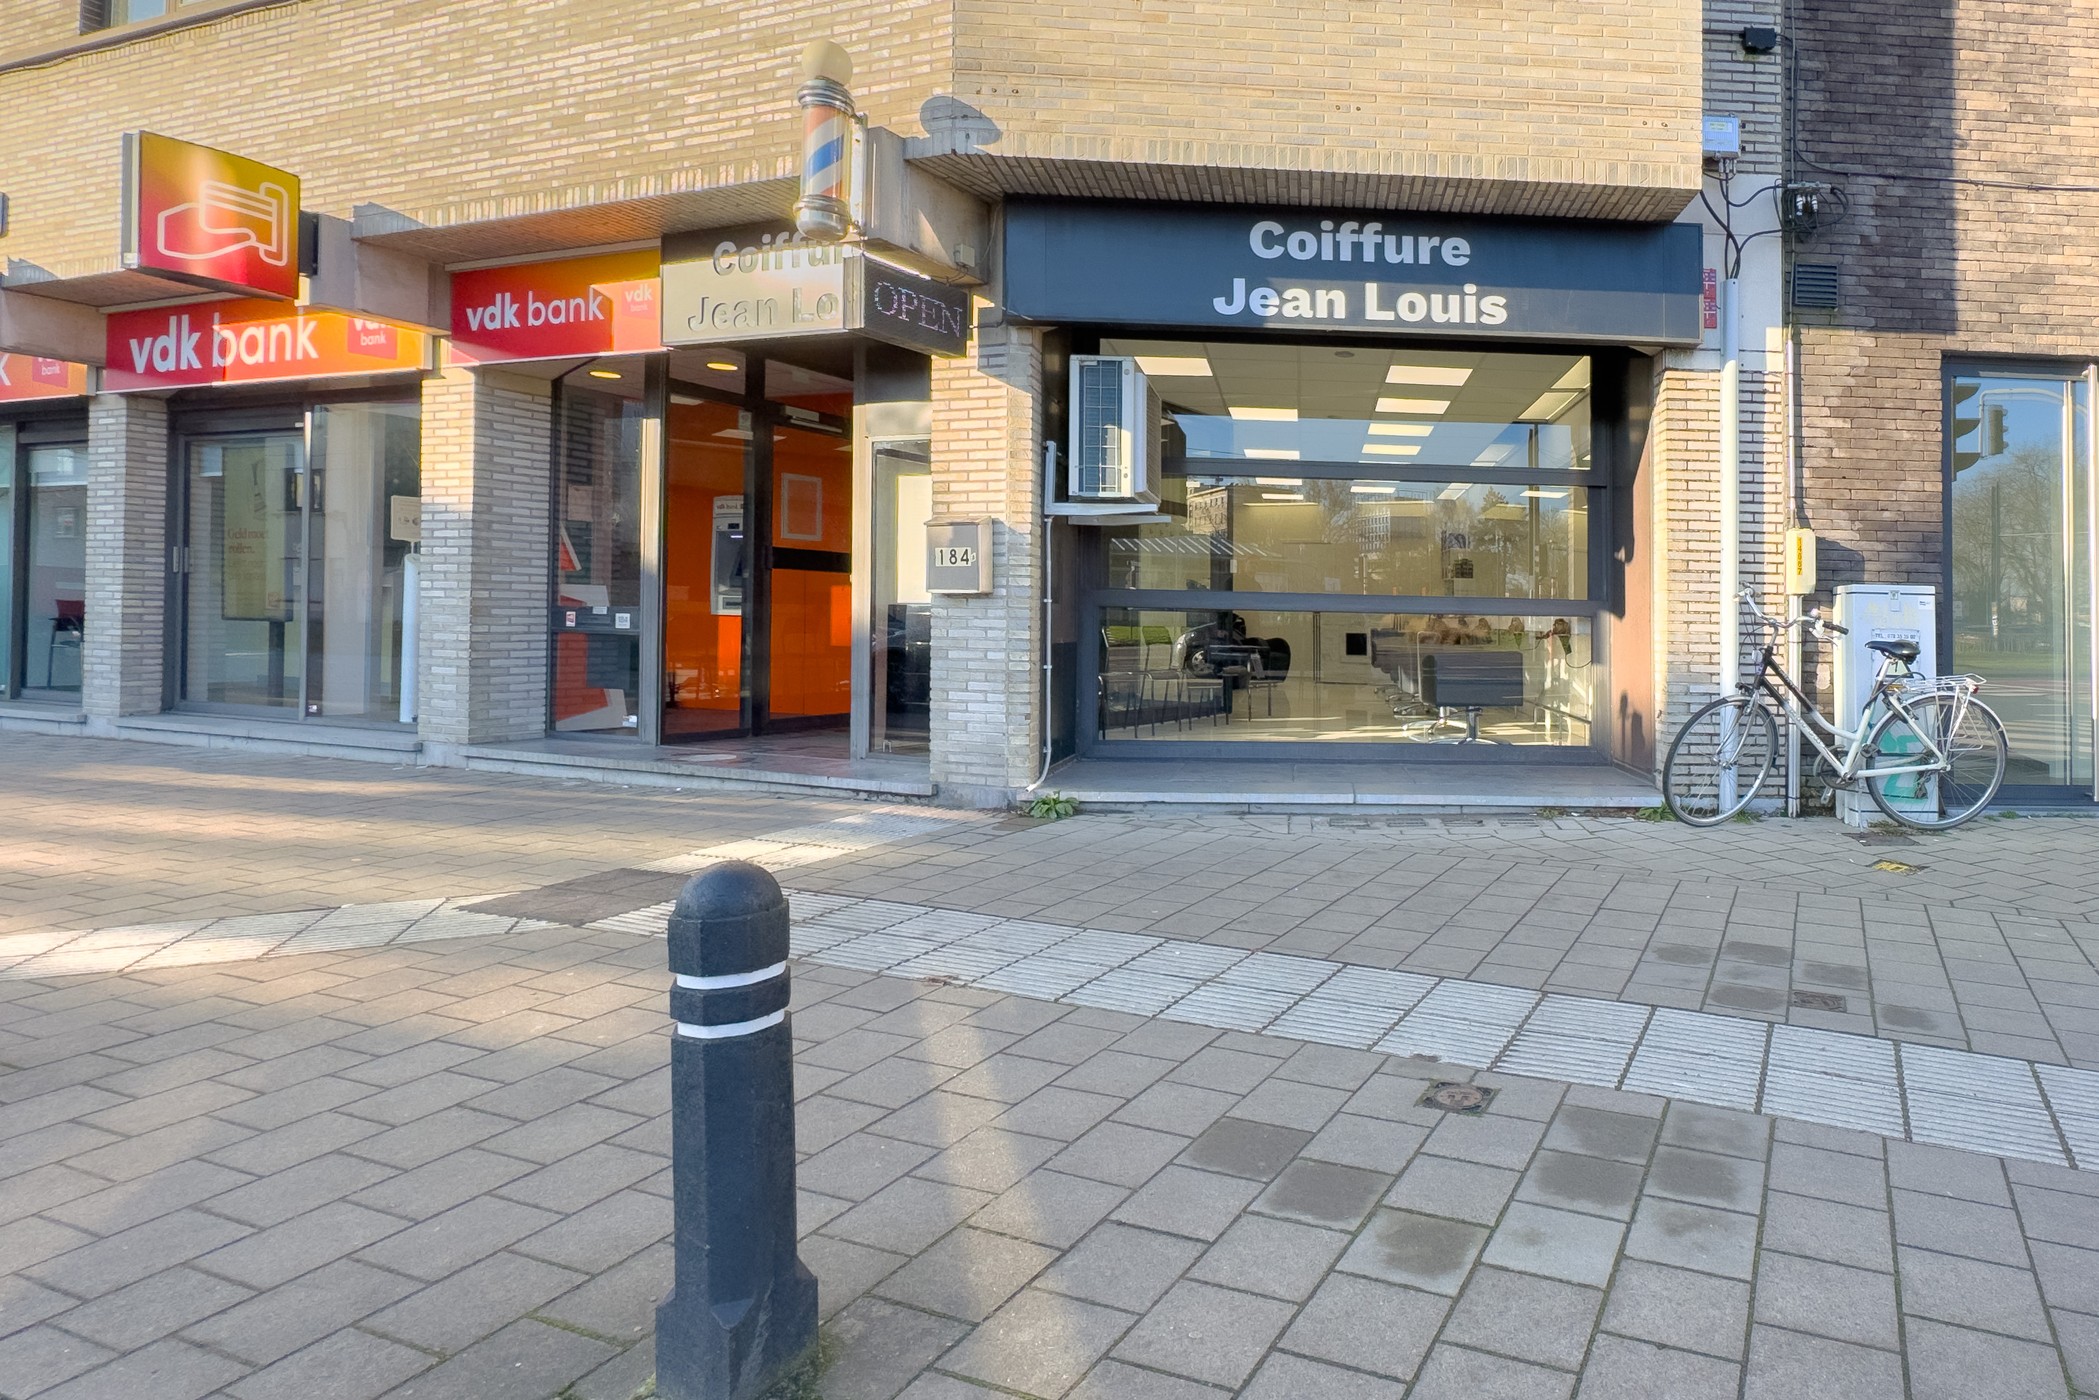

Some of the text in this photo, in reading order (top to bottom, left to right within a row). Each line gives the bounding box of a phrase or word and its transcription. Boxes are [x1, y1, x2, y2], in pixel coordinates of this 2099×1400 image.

[1249, 220, 1471, 267] Coiffure
[466, 286, 604, 332] vdk bank
[624, 284, 653, 302] vdk
[687, 297, 779, 331] Jean
[875, 281, 962, 338] OPEN
[1213, 278, 1508, 325] Jean Louis
[129, 307, 319, 374] vdk bank
[360, 331, 387, 346] bank
[940, 548, 970, 565] 184
